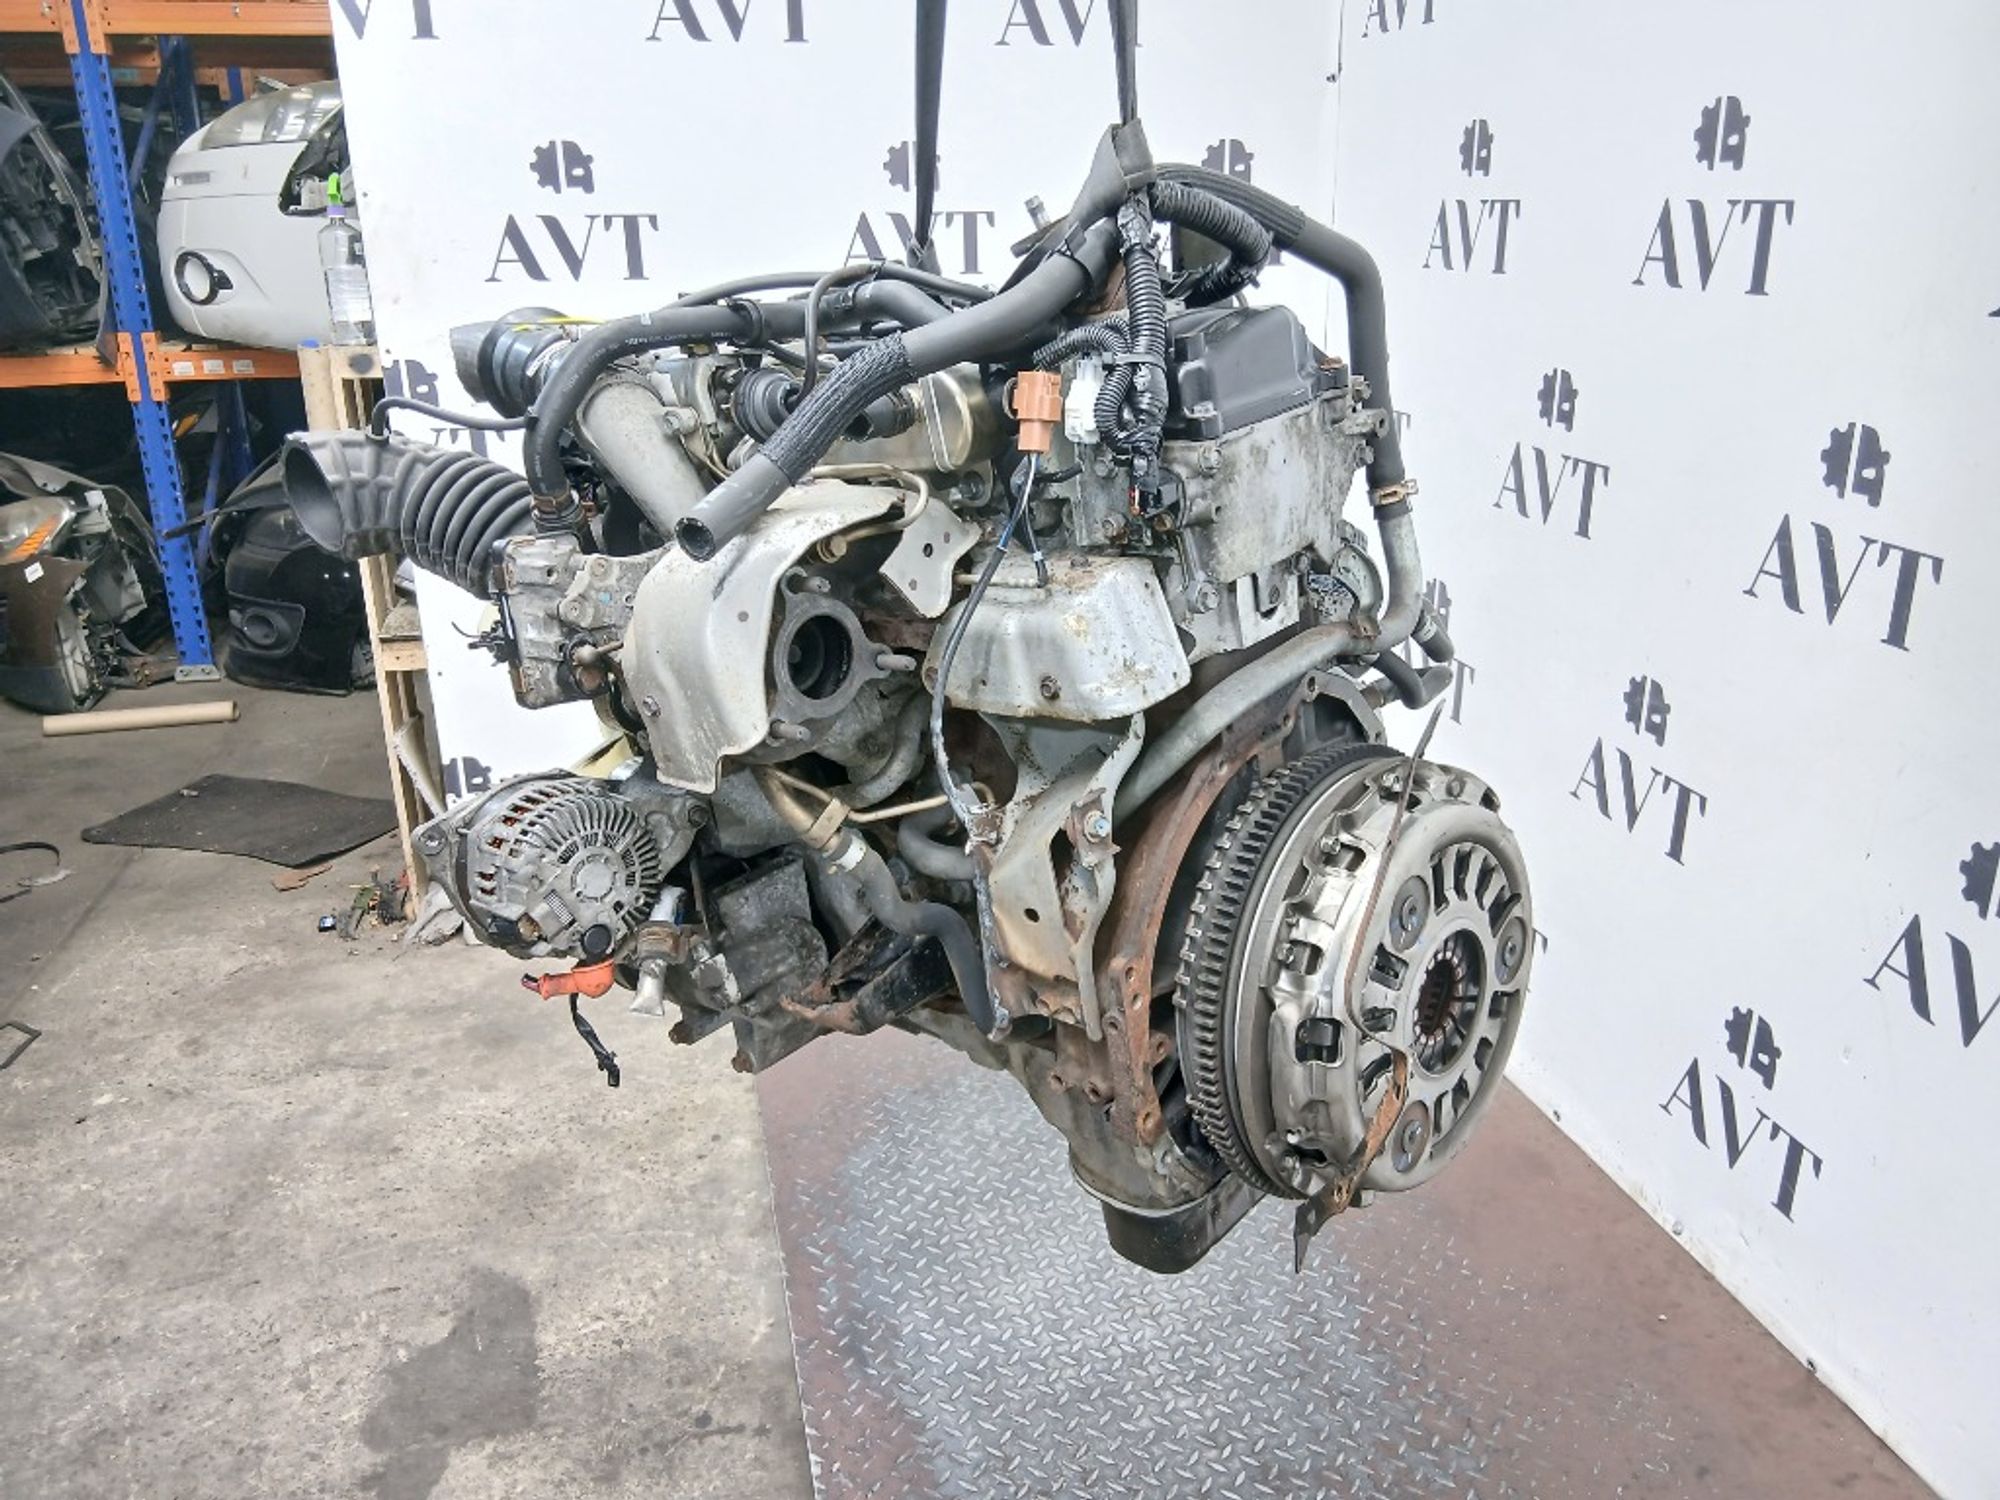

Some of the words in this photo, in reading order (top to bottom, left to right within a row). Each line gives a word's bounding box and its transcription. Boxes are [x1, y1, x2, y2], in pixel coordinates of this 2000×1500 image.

[994, 0, 1142, 47] AV
[484, 213, 659, 283] AVT
[1422, 198, 1521, 275] AVT
[1631, 197, 1795, 296] AVT
[1493, 442, 1610, 541] AVT
[1742, 513, 1945, 652] AVT
[1569, 736, 1708, 867] AVT
[1659, 1057, 1823, 1224] AVT
